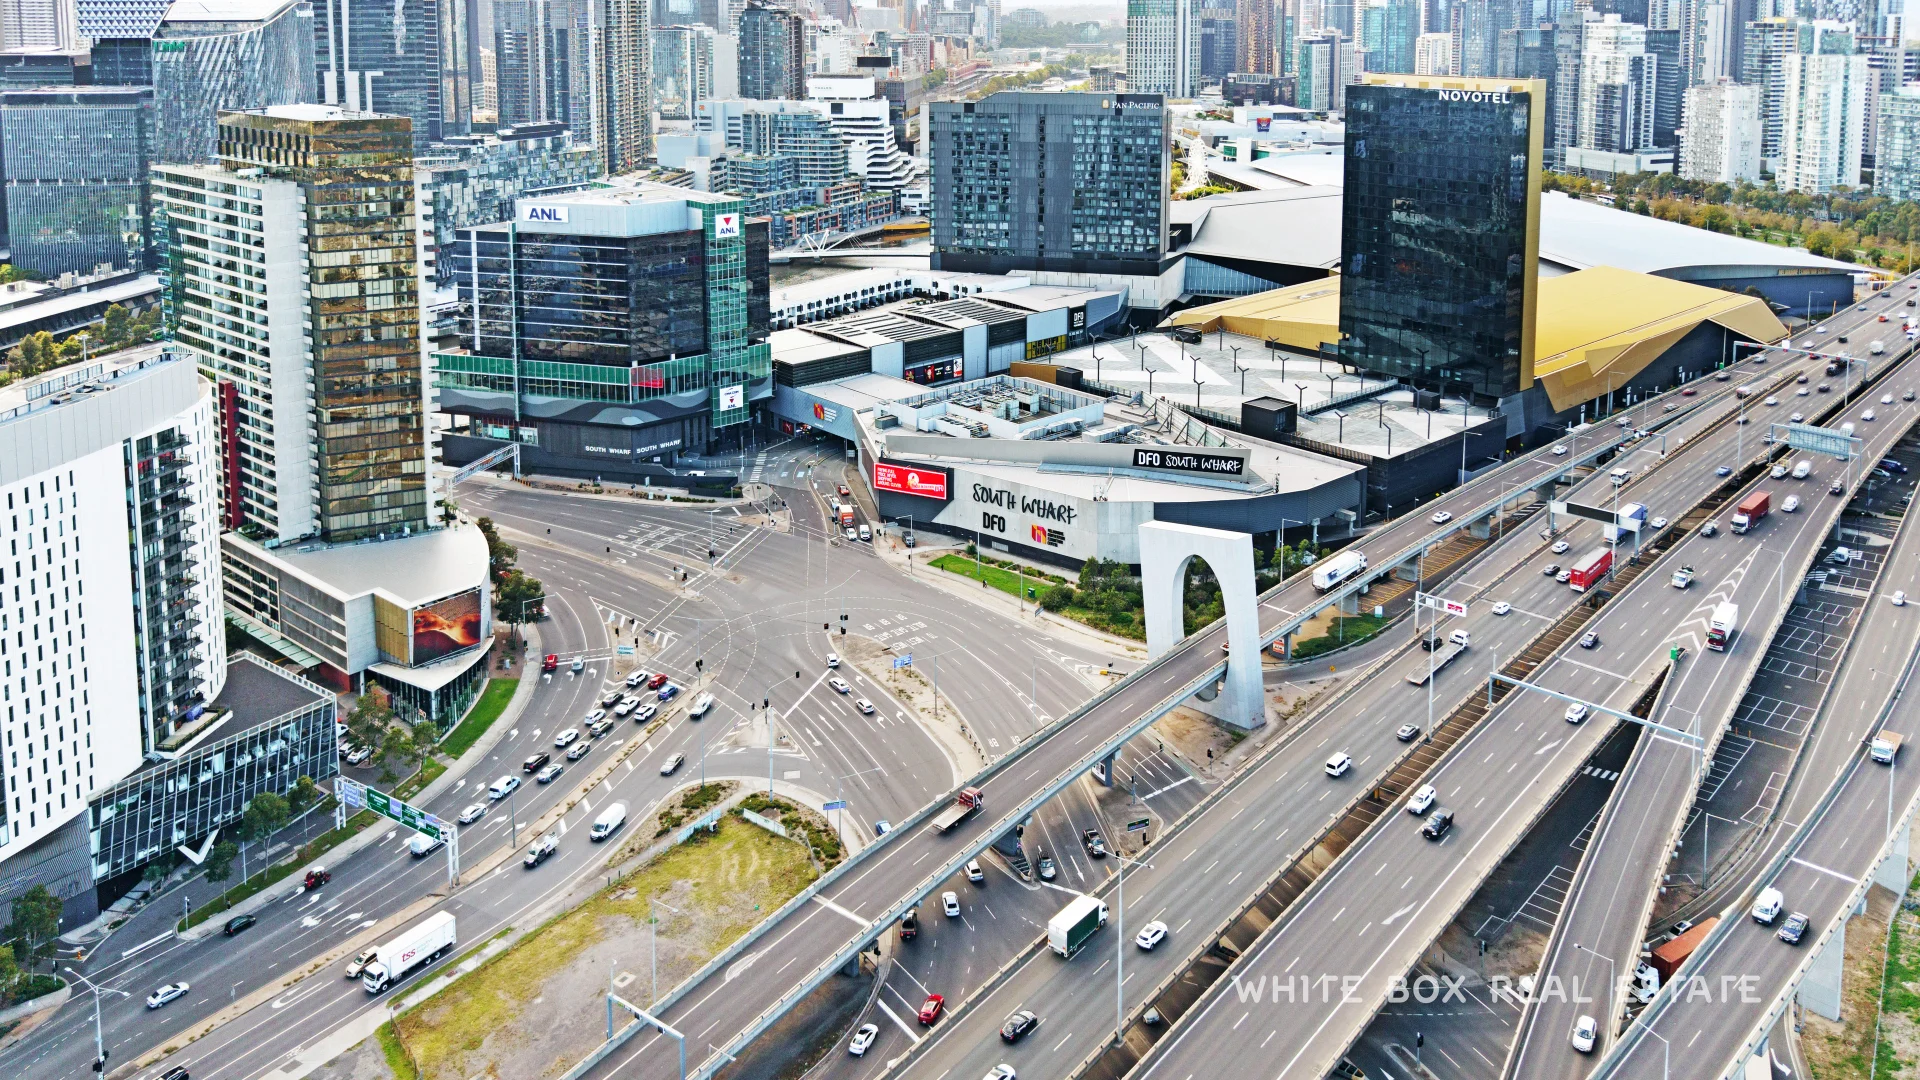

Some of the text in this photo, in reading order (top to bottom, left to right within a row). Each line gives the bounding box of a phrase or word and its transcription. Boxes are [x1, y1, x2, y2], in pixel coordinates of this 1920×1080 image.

[1438, 90, 1510, 104] NOVOTEL
[1111, 101, 1160, 109] PAN PACIFIC
[528, 207, 562, 221] ANL
[719, 227, 737, 235] ANL
[1073, 311, 1084, 322] DFO
[585, 445, 632, 455] SOUTH WHARF
[636, 439, 682, 454] SOUTH WHARF
[1138, 451, 1242, 472] DFO SOUTH WHARF
[973, 483, 1078, 525] SOUTH WHARF
[982, 511, 1006, 533] DFO
[401, 948, 416, 963] tss
